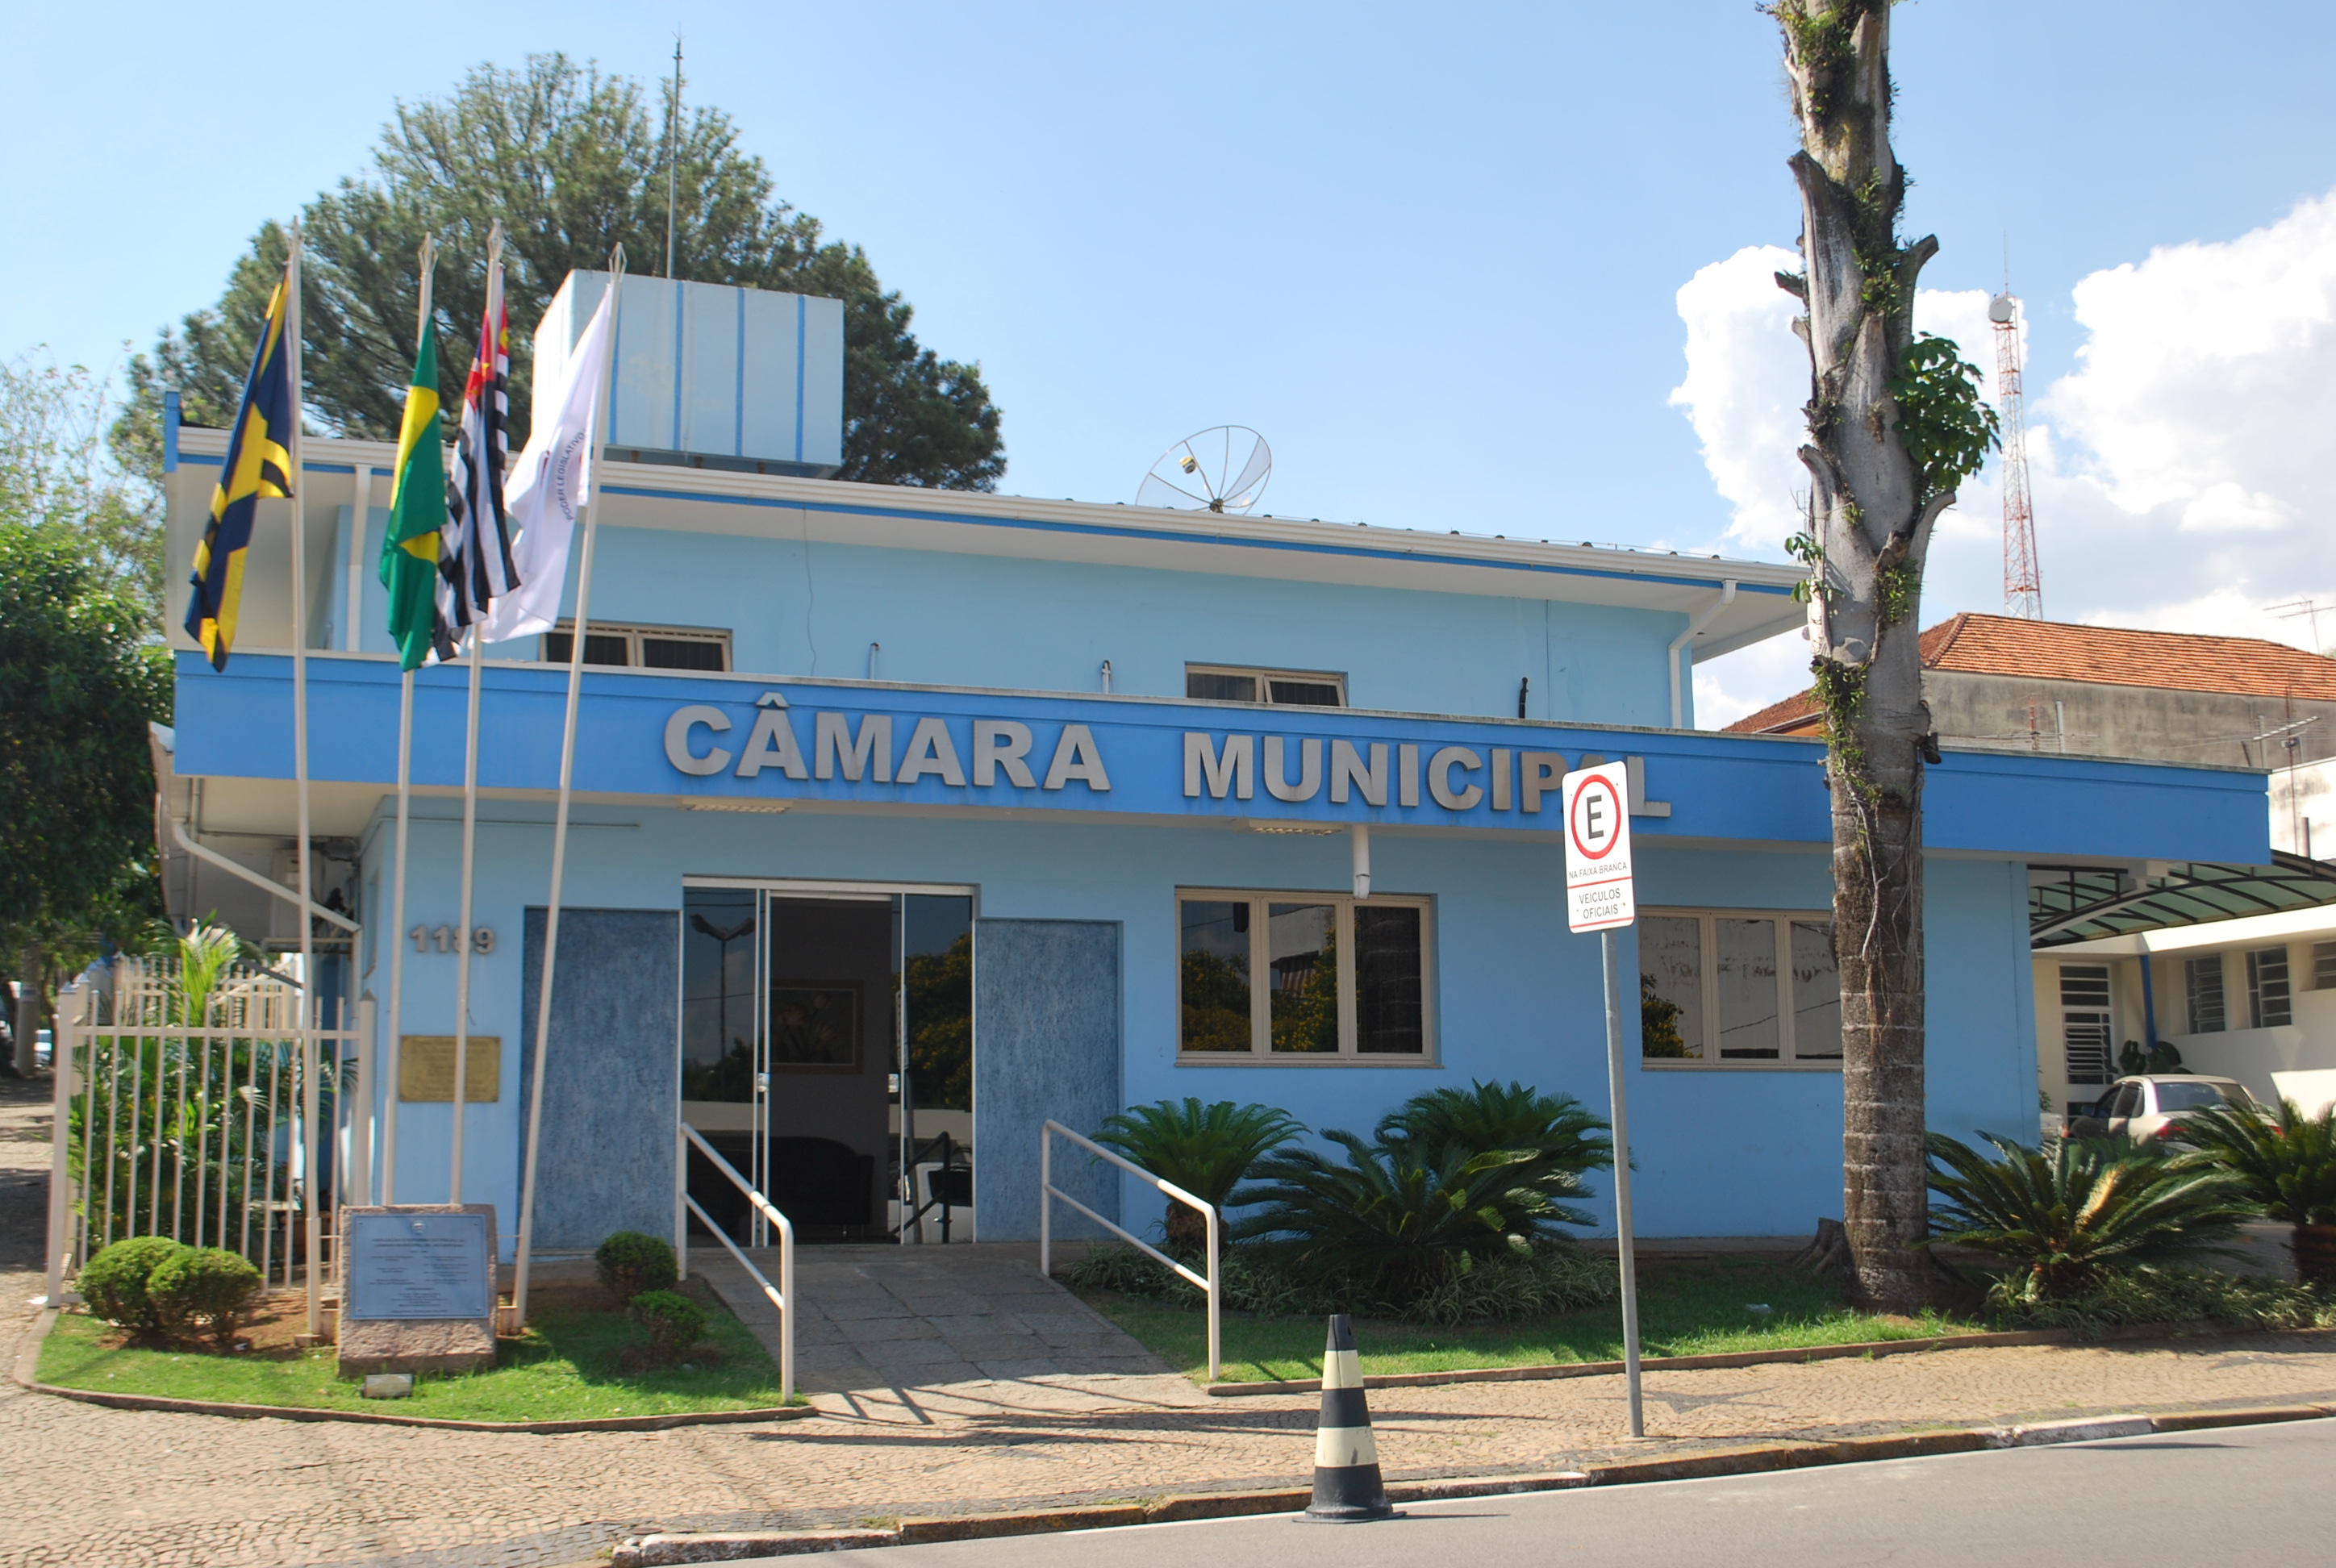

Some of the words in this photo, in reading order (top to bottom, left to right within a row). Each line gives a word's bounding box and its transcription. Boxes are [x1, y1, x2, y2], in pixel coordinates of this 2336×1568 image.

[557, 432, 585, 486] LEGISLATIVO
[557, 488, 574, 520] PODER
[664, 691, 1112, 791] CÂMARA
[1183, 732, 1671, 818] MUNICIPL
[1587, 794, 1604, 840] E
[1569, 869, 1579, 880] NA
[1579, 865, 1598, 878] FAIXA
[1600, 861, 1628, 875] BRANCA
[1579, 888, 1621, 904] VEÍCULOS
[1583, 904, 1618, 919] OFICIAIS
